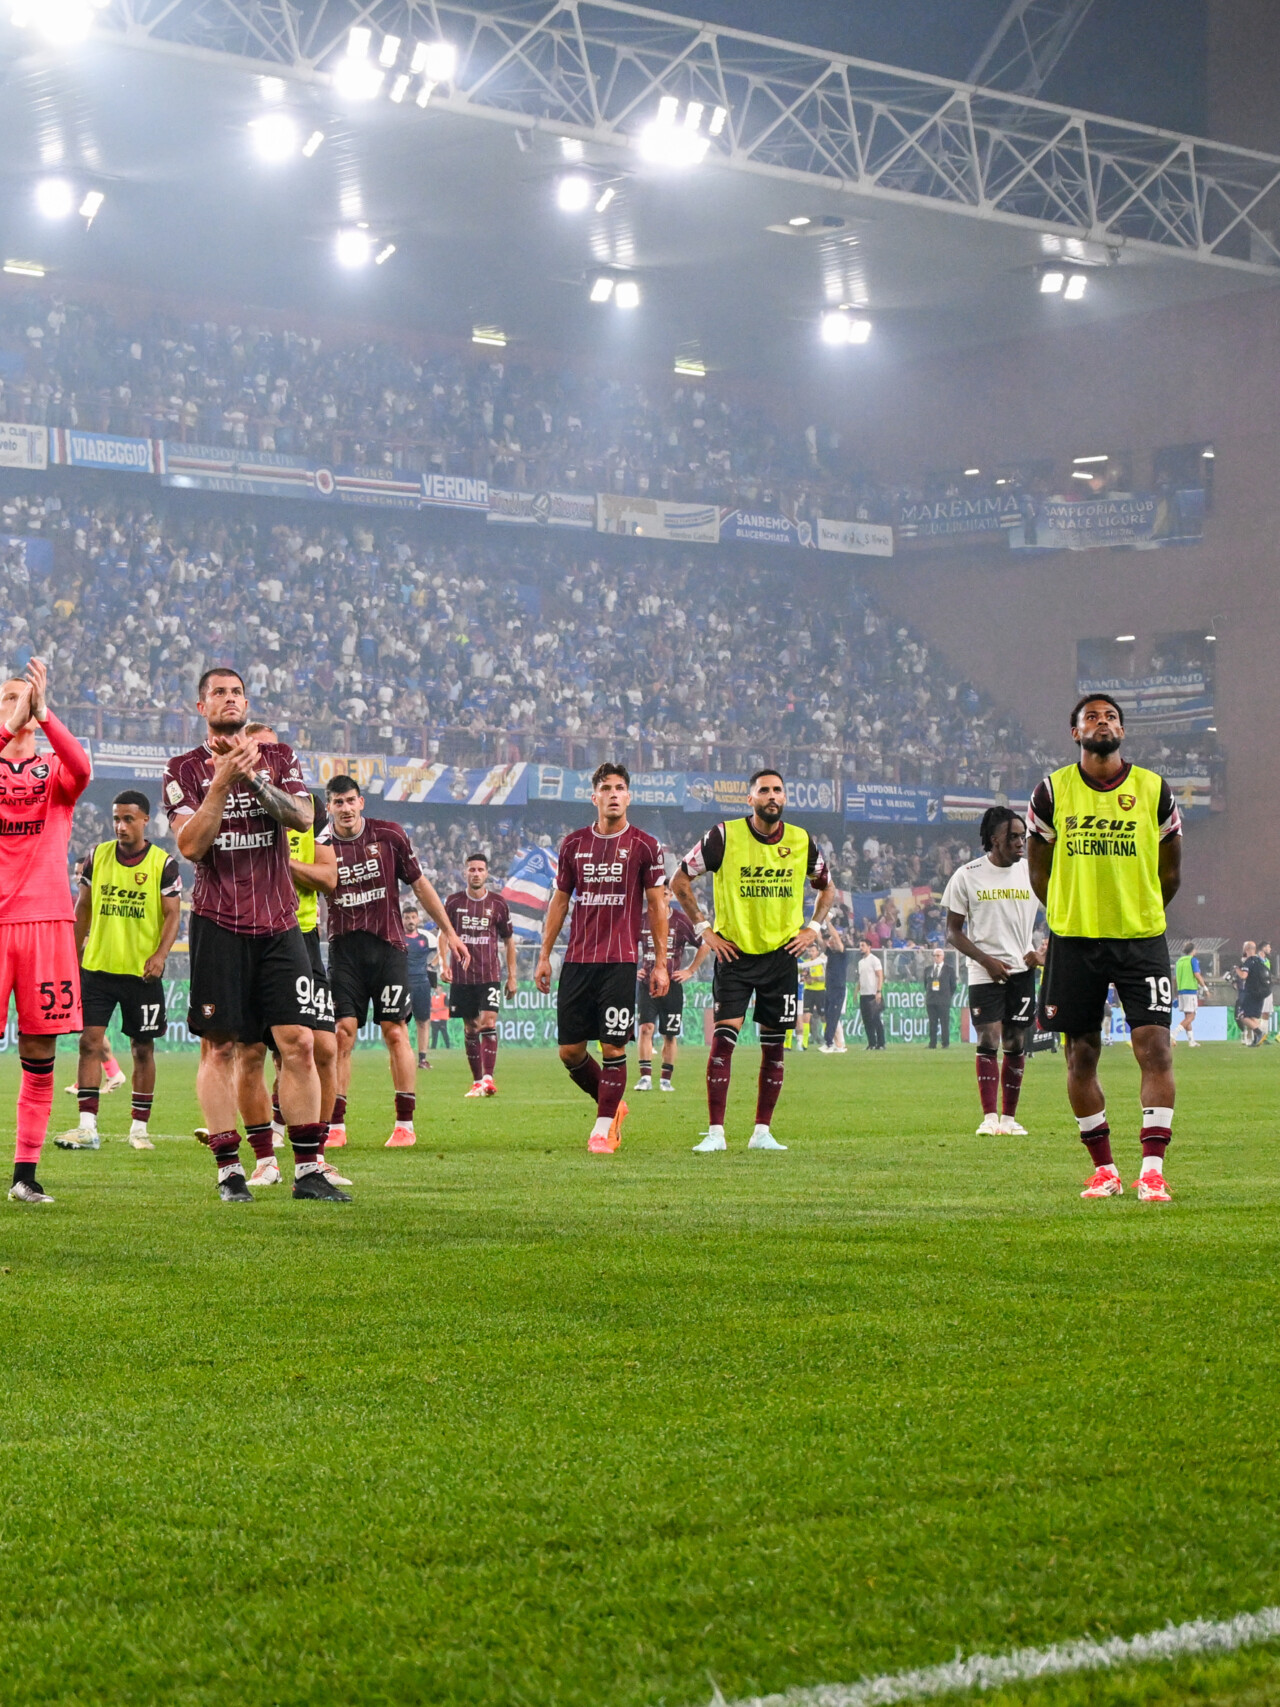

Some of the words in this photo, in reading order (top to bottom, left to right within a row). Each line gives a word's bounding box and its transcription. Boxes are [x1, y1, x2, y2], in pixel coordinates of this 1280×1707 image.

[9, 427, 28, 438] CLUB
[72, 437, 147, 467] VIAREGGIO
[170, 442, 257, 465] SAMPDORIA
[260, 450, 295, 467] CLUB
[354, 466, 394, 480] CUNEO
[207, 478, 255, 494] MALTA
[421, 473, 488, 502] VERONA
[901, 495, 1019, 521] MAREMMA
[1044, 503, 1117, 517] SAMPDORIA
[1121, 501, 1154, 513] CLUB
[736, 513, 791, 533] SANREMO
[1098, 514, 1147, 528] LIGURE
[100, 742, 166, 757] SAMPDORIA
[857, 784, 903, 796] SAMPDORIA
[222, 806, 269, 821] SANTER
[1080, 815, 1138, 832] Zeus
[1116, 831, 1136, 840] dei
[1066, 839, 1137, 857] SALERNITANA
[341, 871, 381, 886] SANTERO
[584, 875, 622, 884] SANTERO
[754, 867, 794, 878] Zeus
[110, 886, 148, 900] Zeus
[740, 885, 793, 898] SALERNITANA
[976, 889, 1030, 901] SALERNITANA
[40, 981, 74, 1011] 53
[381, 985, 403, 1007] 47
[1145, 976, 1172, 1005] 19
[782, 993, 797, 1016] 15
[1019, 997, 1031, 1017] 7
[44, 1012, 71, 1020] Zeus
[141, 1003, 161, 1026] 17
[605, 1006, 630, 1029] 99
[667, 1013, 681, 1028] 73
[607, 1028, 626, 1037] Zeus
